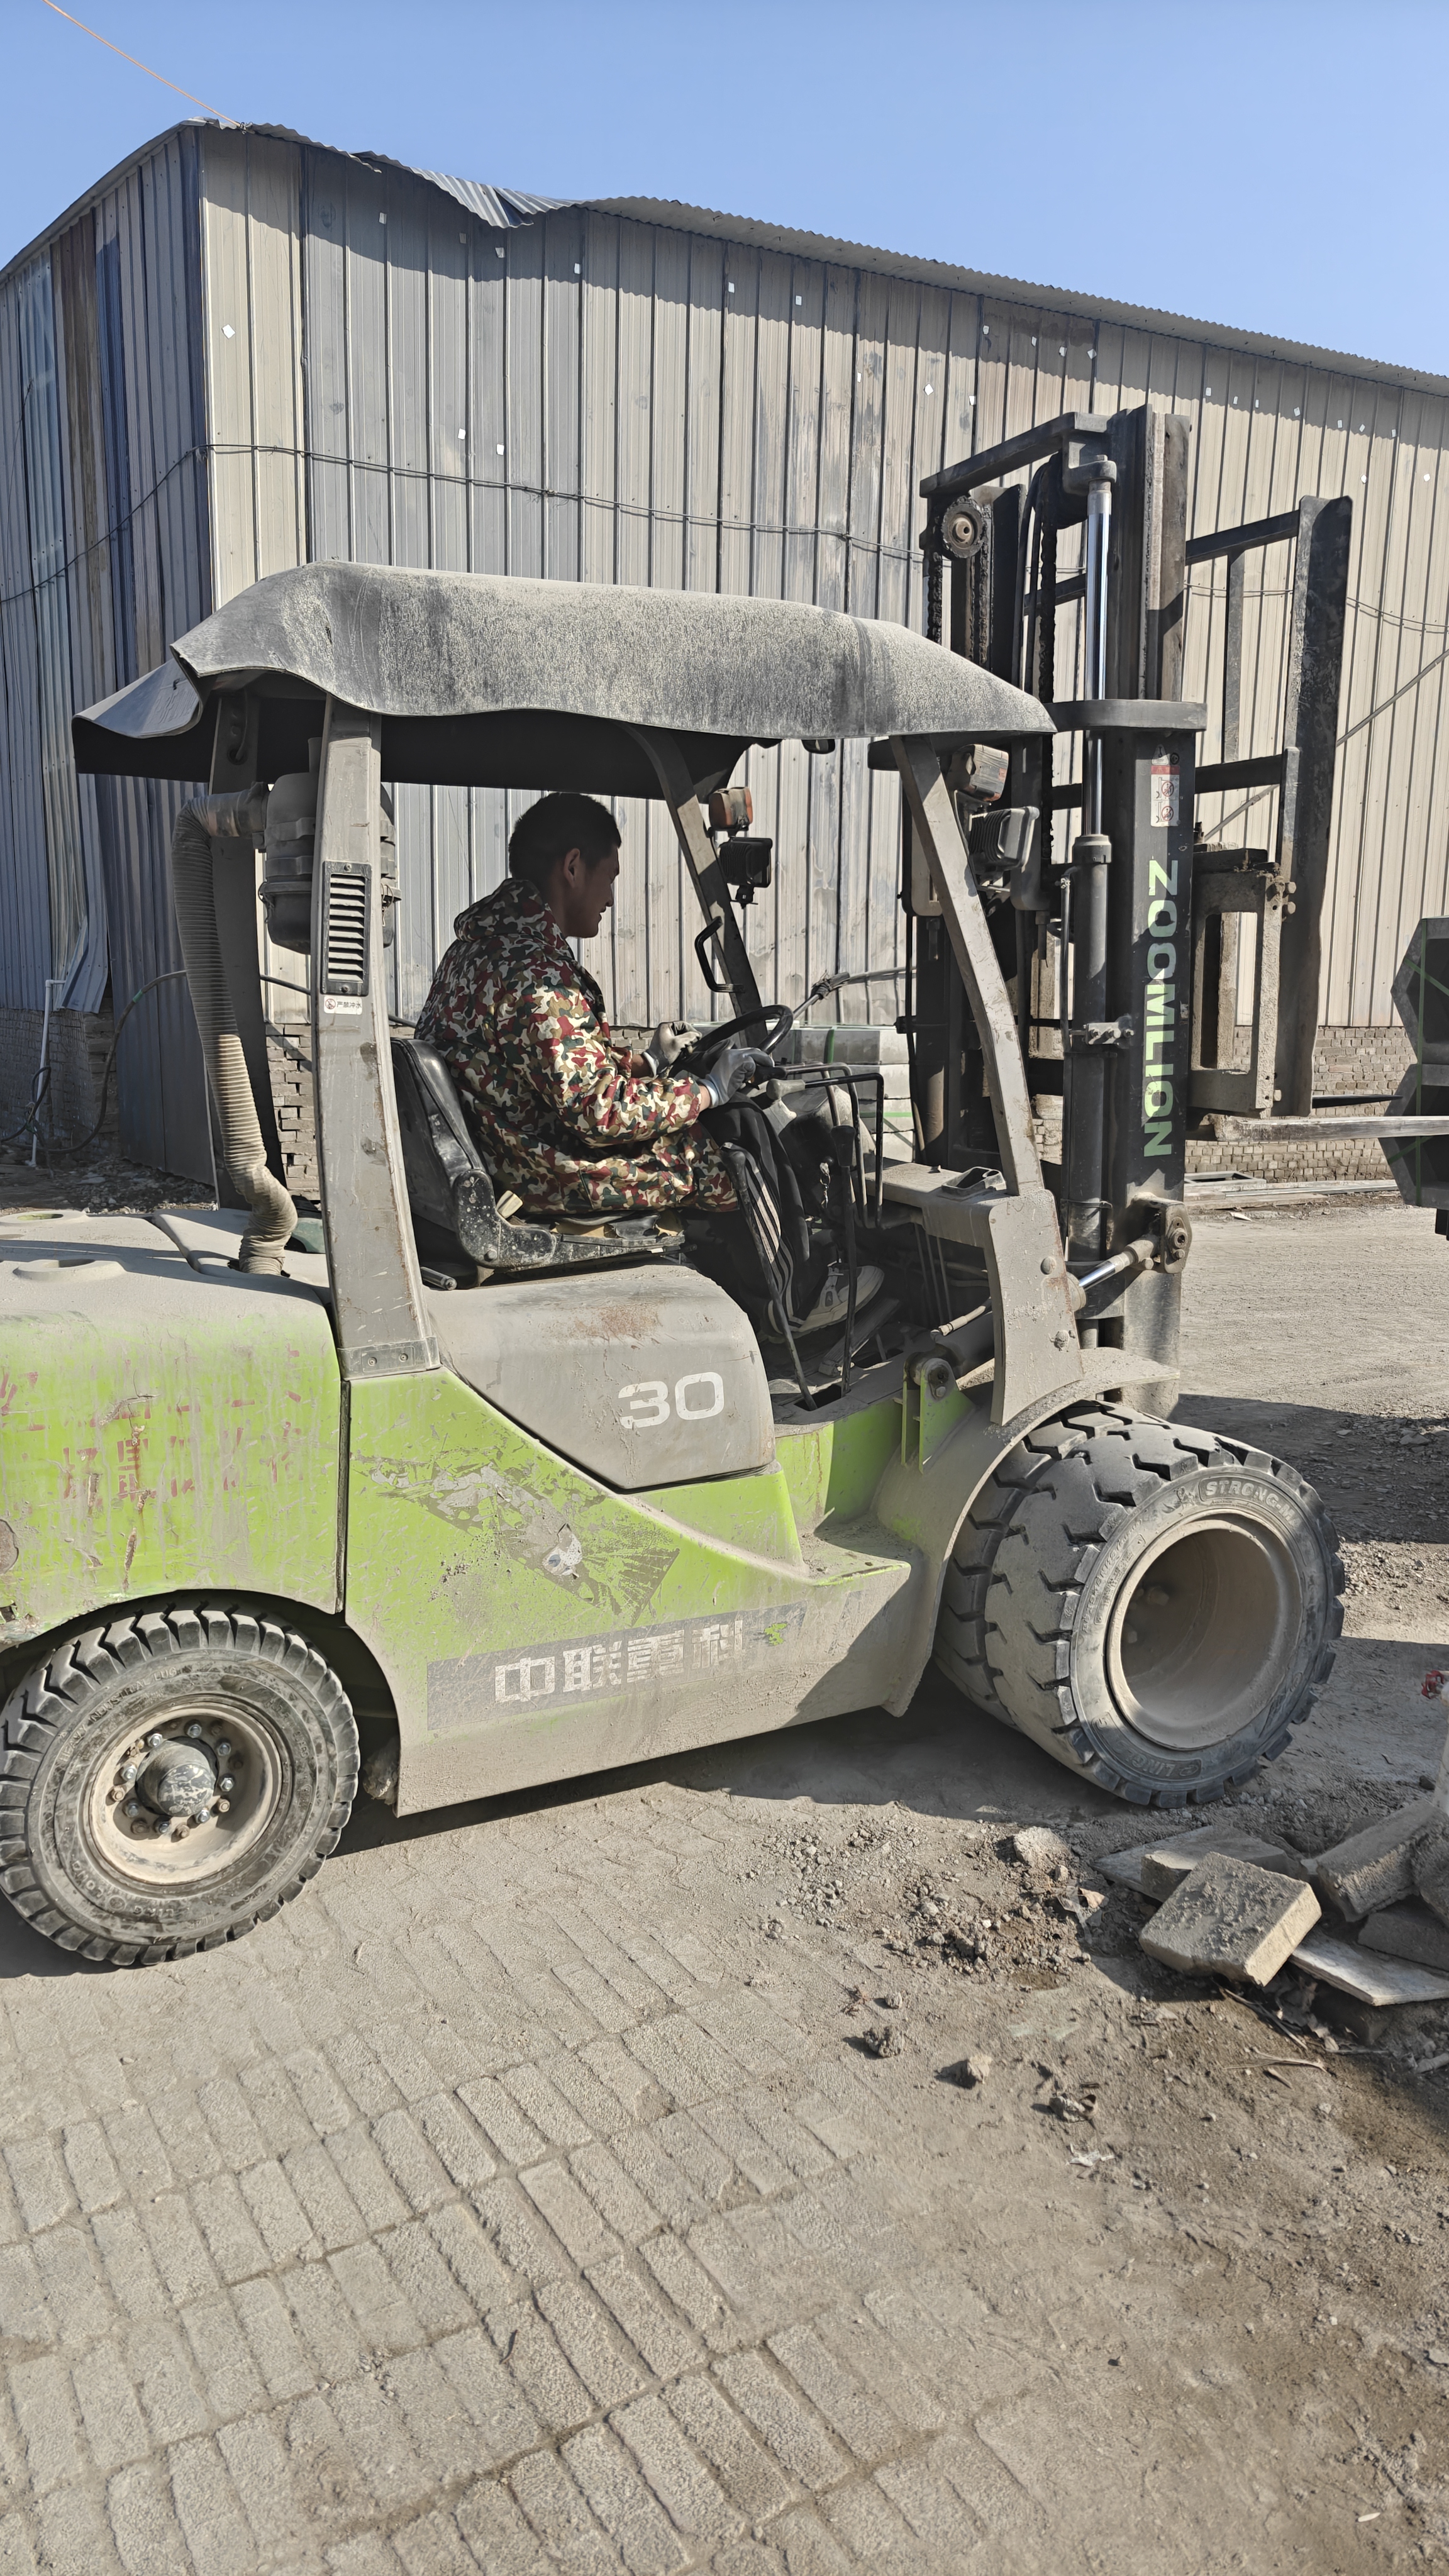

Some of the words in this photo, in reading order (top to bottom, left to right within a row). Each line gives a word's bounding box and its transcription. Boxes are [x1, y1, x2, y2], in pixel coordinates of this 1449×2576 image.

[1143, 859, 1179, 1157] ZOOMLION
[618, 1372, 724, 1429] 30
[60, 1724, 87, 1762] HEAVY
[88, 1679, 151, 1723] INDUSTRIAL
[153, 1666, 177, 1682] LUG
